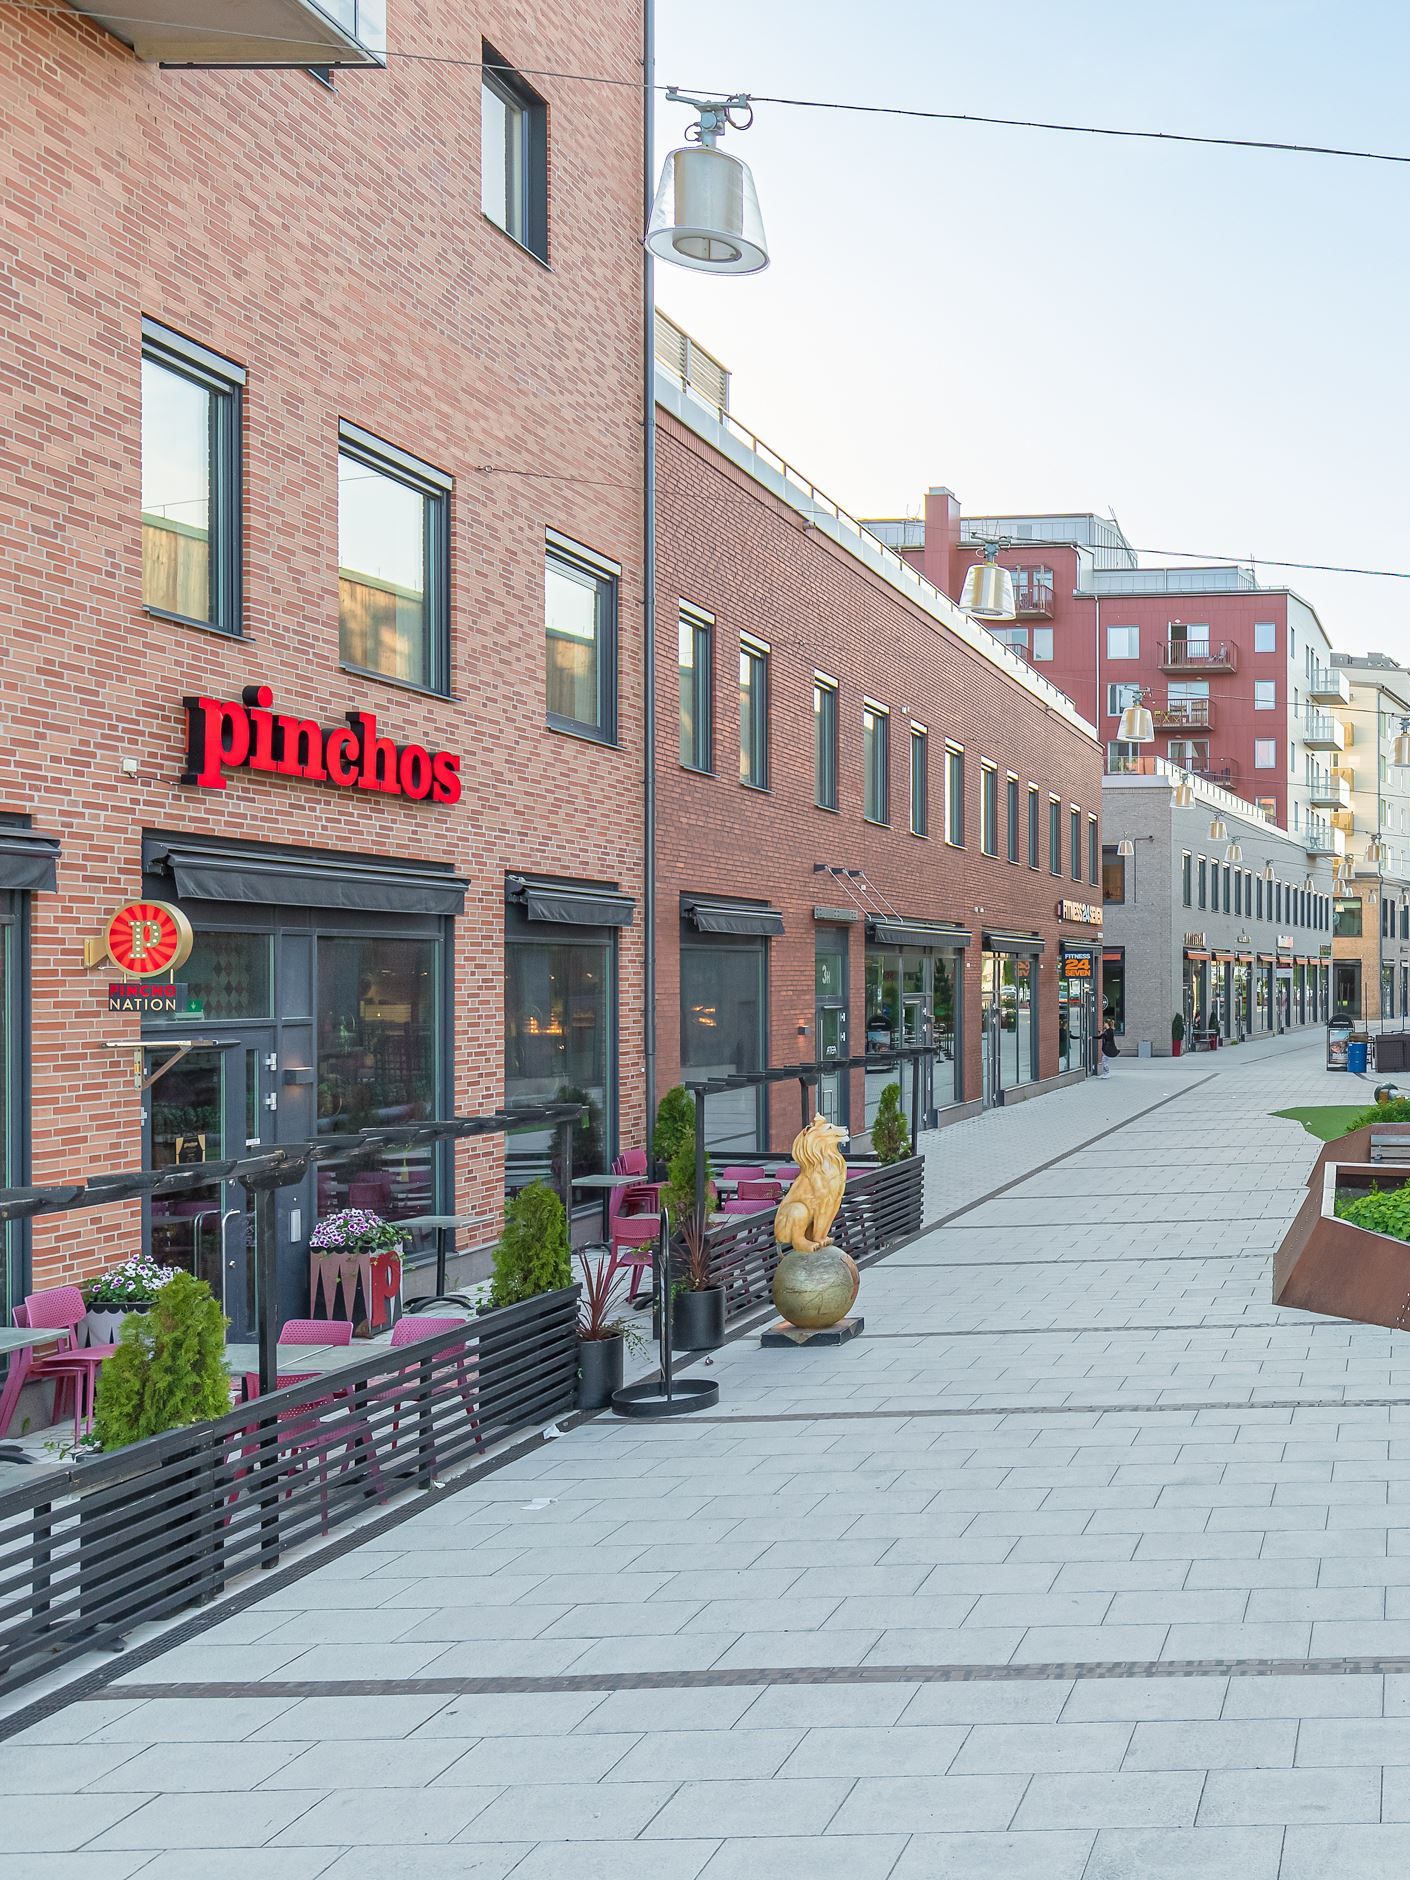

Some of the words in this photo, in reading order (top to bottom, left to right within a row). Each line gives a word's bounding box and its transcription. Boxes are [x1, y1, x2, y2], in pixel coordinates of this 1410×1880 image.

[190, 685, 461, 804] pinchos
[1065, 959, 1091, 970] 24
[1065, 969, 1091, 977] SEVEN
[109, 985, 176, 998] PINCHO
[109, 998, 176, 1011] NATION
